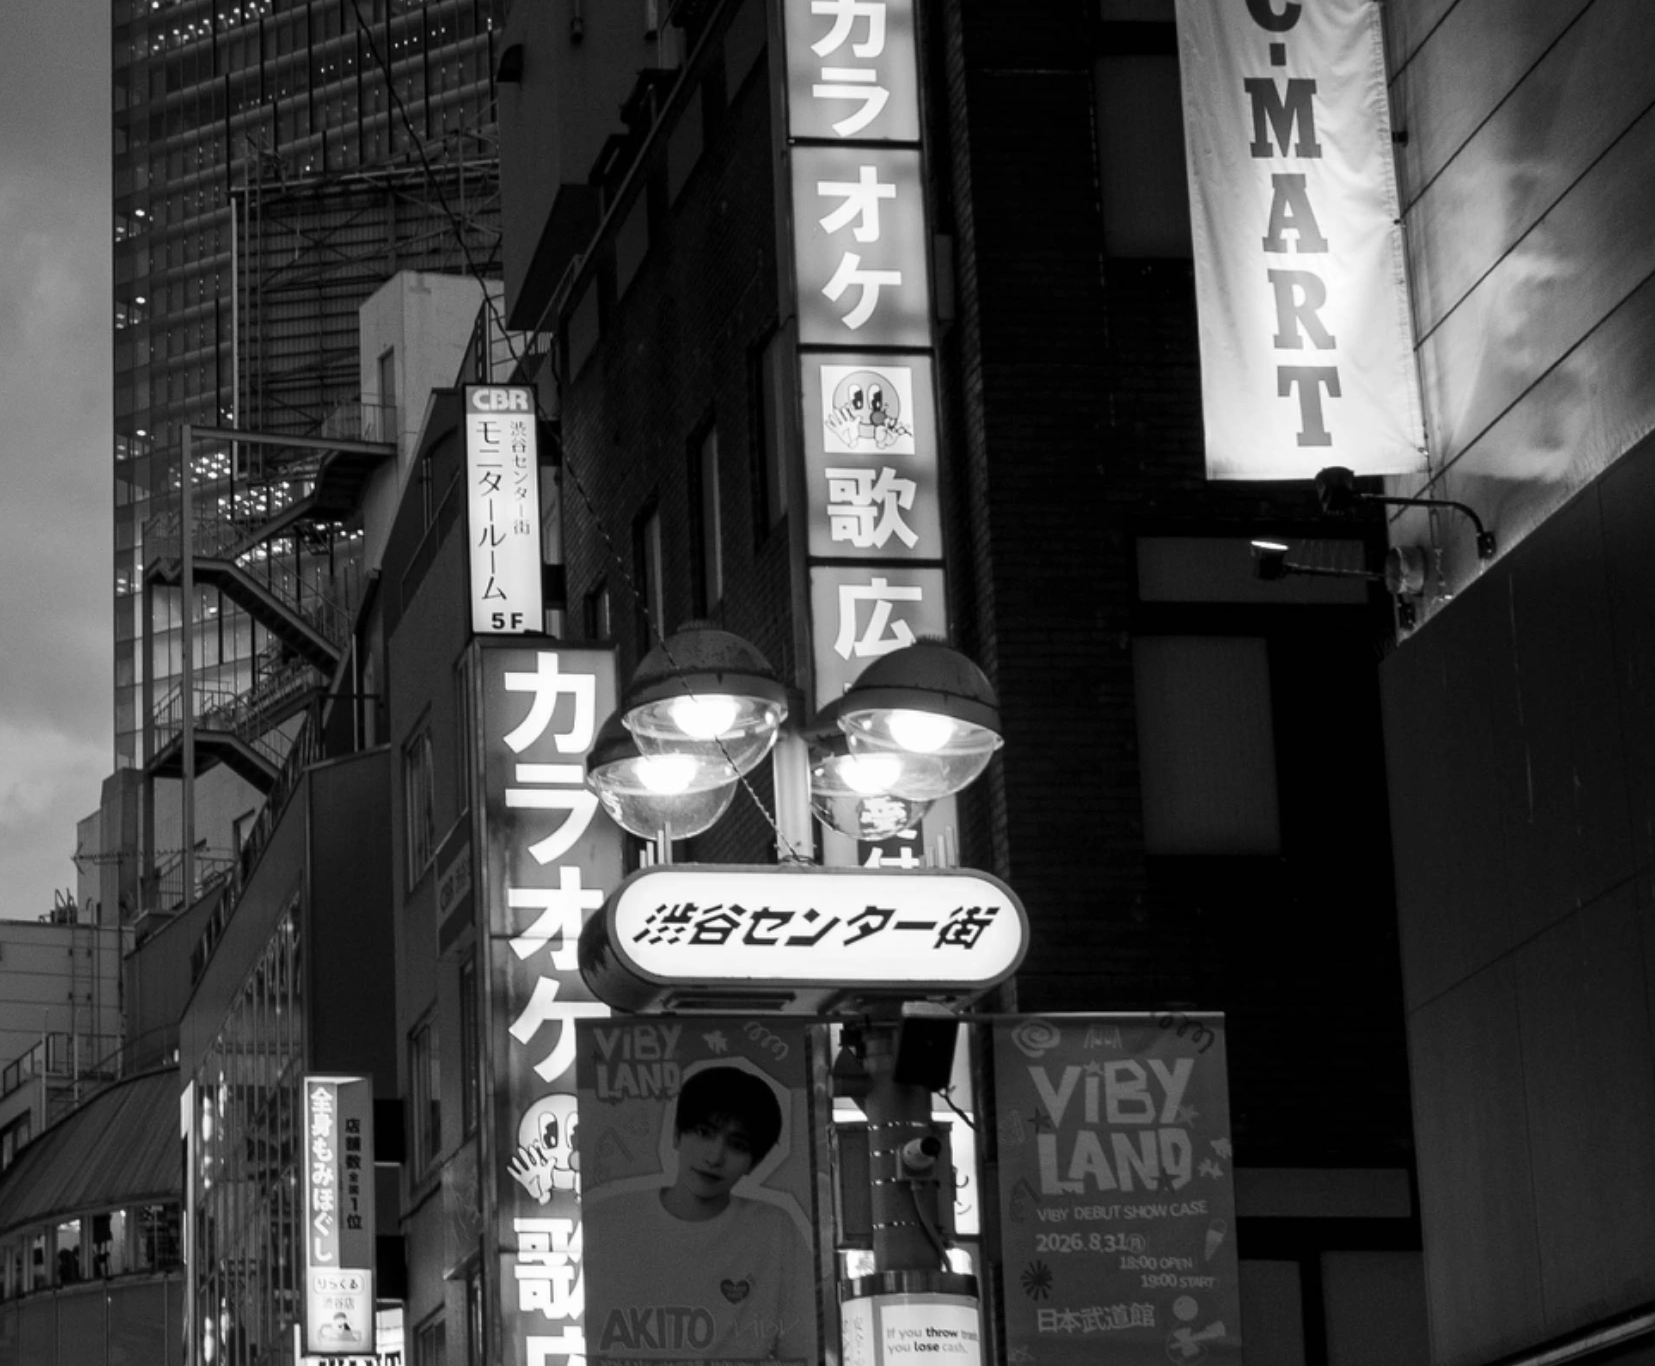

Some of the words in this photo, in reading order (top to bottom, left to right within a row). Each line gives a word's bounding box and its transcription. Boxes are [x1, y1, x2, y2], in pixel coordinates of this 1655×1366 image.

[472, 388, 530, 412] CBR
[509, 421, 533, 537] 渋谷センター街
[474, 420, 507, 602] モニタールーム
[825, 467, 926, 663] 歌広
[490, 613, 524, 629] 5F
[503, 651, 612, 1083] カラオケ
[633, 902, 999, 949] 渋谷センター街
[308, 1085, 335, 1264] 全身もみほぐし
[1038, 1129, 1193, 1197] LAND
[1074, 1204, 1121, 1221] DEBUT
[1123, 1203, 1169, 1220] SHOW
[1170, 1199, 1209, 1217] CASE
[1118, 1255, 1156, 1271] 18:00
[1159, 1256, 1194, 1271] OPEN
[316, 1278, 360, 1293] りらくる
[1140, 1273, 1178, 1289] 19:00
[1179, 1275, 1216, 1289] START
[599, 1306, 716, 1351] AKITO
[1037, 1303, 1156, 1333] 日本武道館
[888, 1342, 912, 1355] you
[913, 1341, 940, 1353] lose
[898, 1328, 923, 1341] you
[925, 1327, 959, 1339] throw
